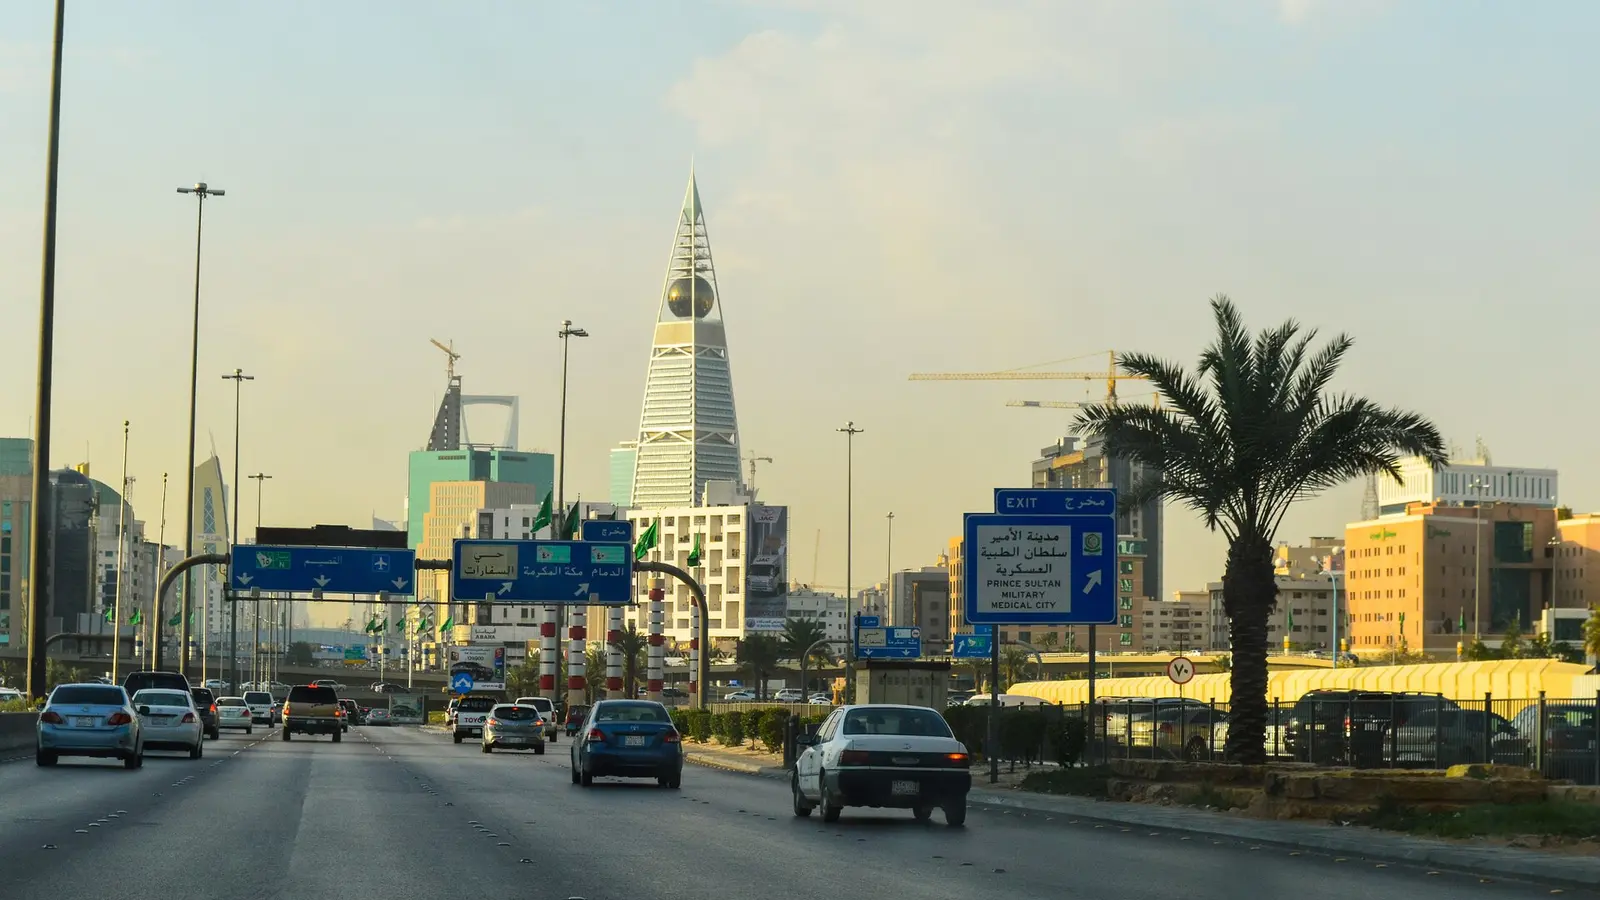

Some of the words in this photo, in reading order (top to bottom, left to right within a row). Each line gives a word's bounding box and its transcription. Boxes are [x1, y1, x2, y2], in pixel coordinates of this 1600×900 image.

[1006, 497, 1038, 508] EXIT
[1065, 496, 1106, 510] مخرج
[601, 526, 626, 536] مخرج
[990, 527, 1022, 544] الأمير
[1027, 531, 1060, 542] مدينة
[473, 549, 505, 563] حي
[980, 546, 1020, 560] الطبية
[1024, 546, 1068, 560] سلطان
[304, 555, 343, 568] القصيم
[464, 565, 514, 577] السفارات
[523, 565, 561, 578] المكرمة
[564, 565, 583, 576] مكة
[591, 567, 624, 577] الدمام
[995, 563, 1052, 577] العسكرية
[986, 580, 1022, 588] PRINCE
[1024, 580, 1061, 588] SULTAN
[1001, 591, 1046, 599] MILITARY
[1173, 663, 1189, 677] ٧٠
